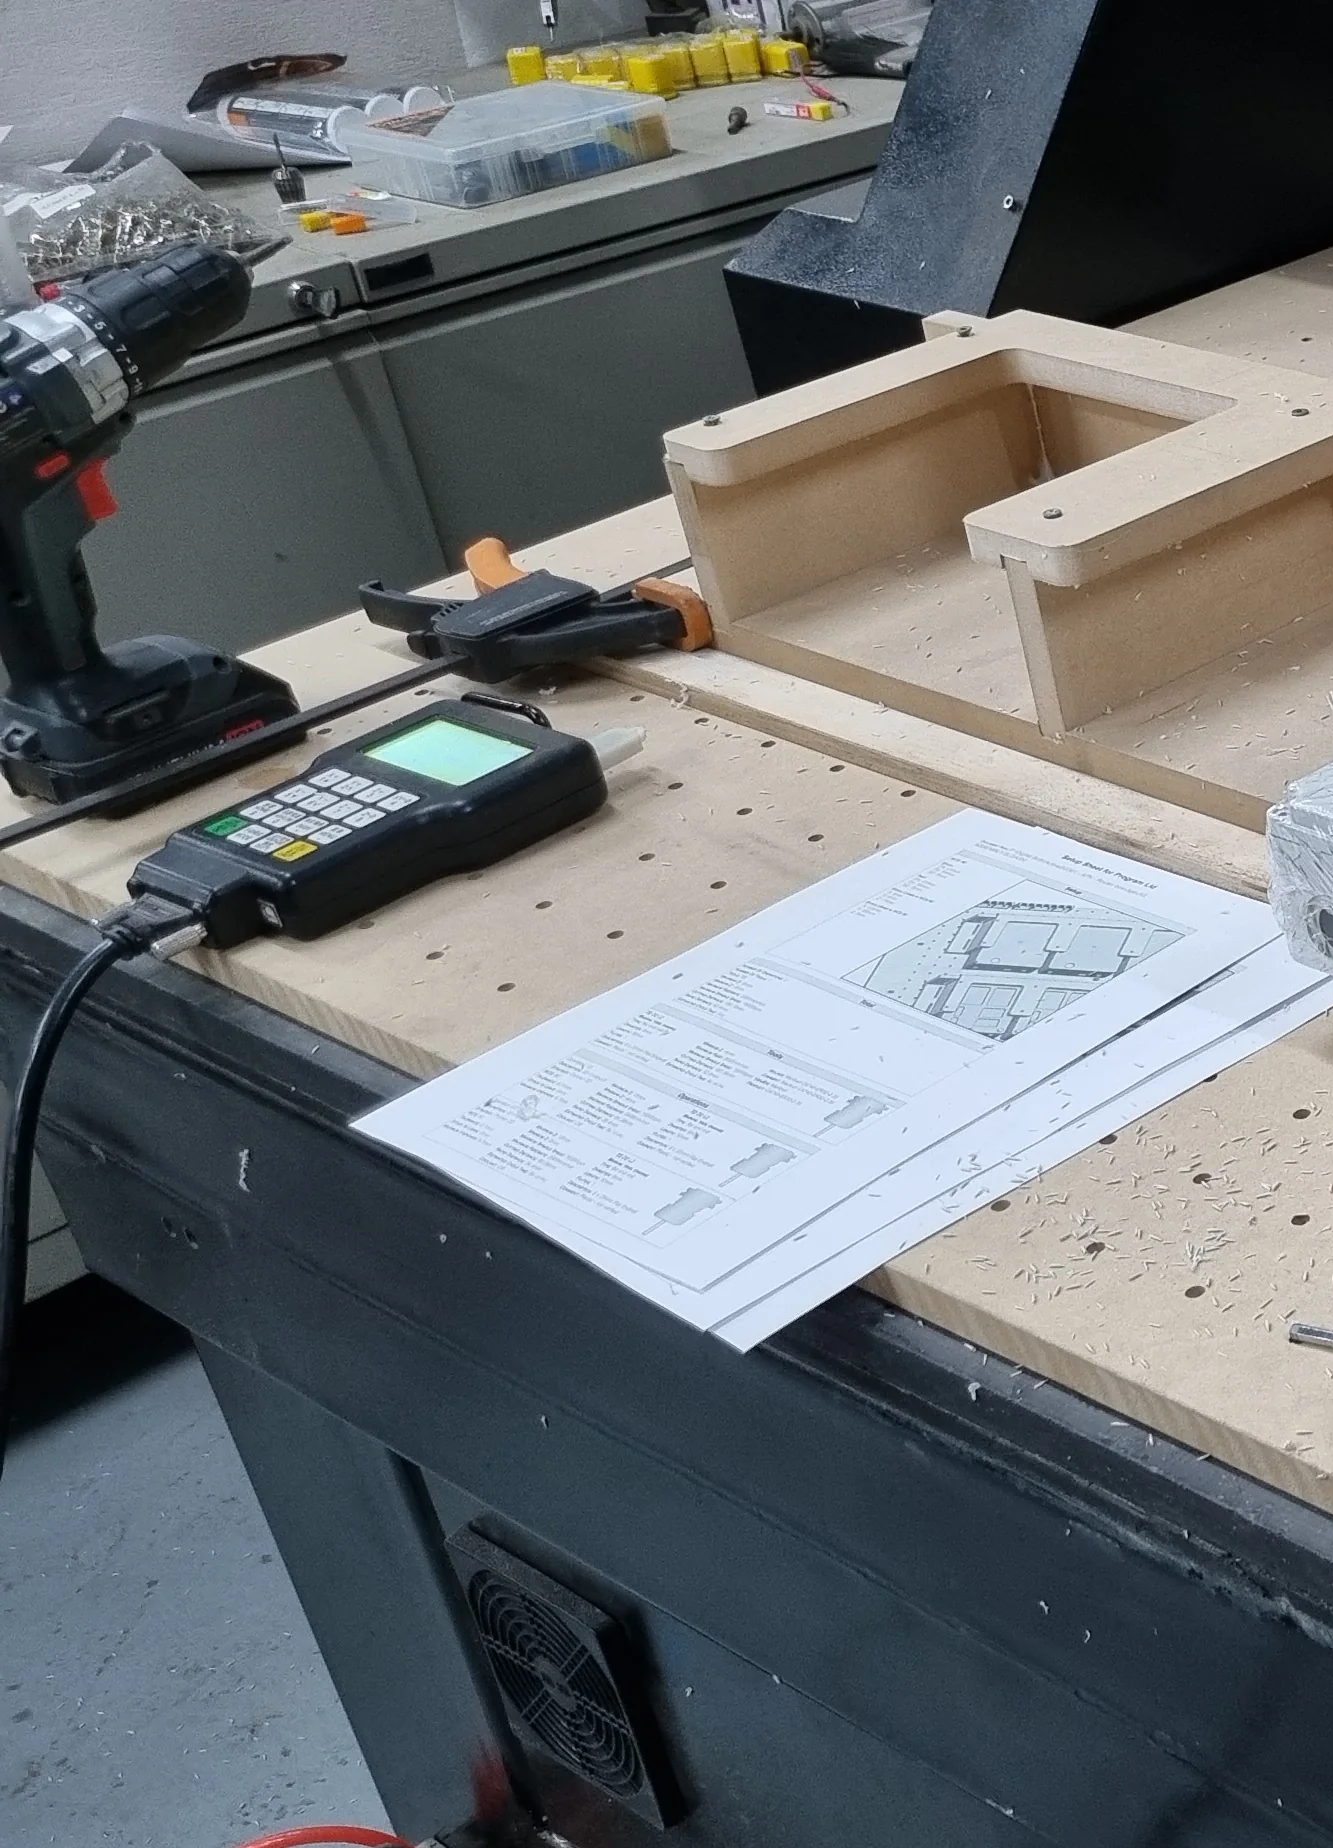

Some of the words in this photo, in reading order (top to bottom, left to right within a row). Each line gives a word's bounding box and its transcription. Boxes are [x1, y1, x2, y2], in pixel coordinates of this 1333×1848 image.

[73, 304, 86, 313] 3
[116, 344, 128, 353] 7
[128, 365, 139, 375] 9
[1061, 854, 1083, 866] Setup
[1113, 871, 1144, 887] Program
